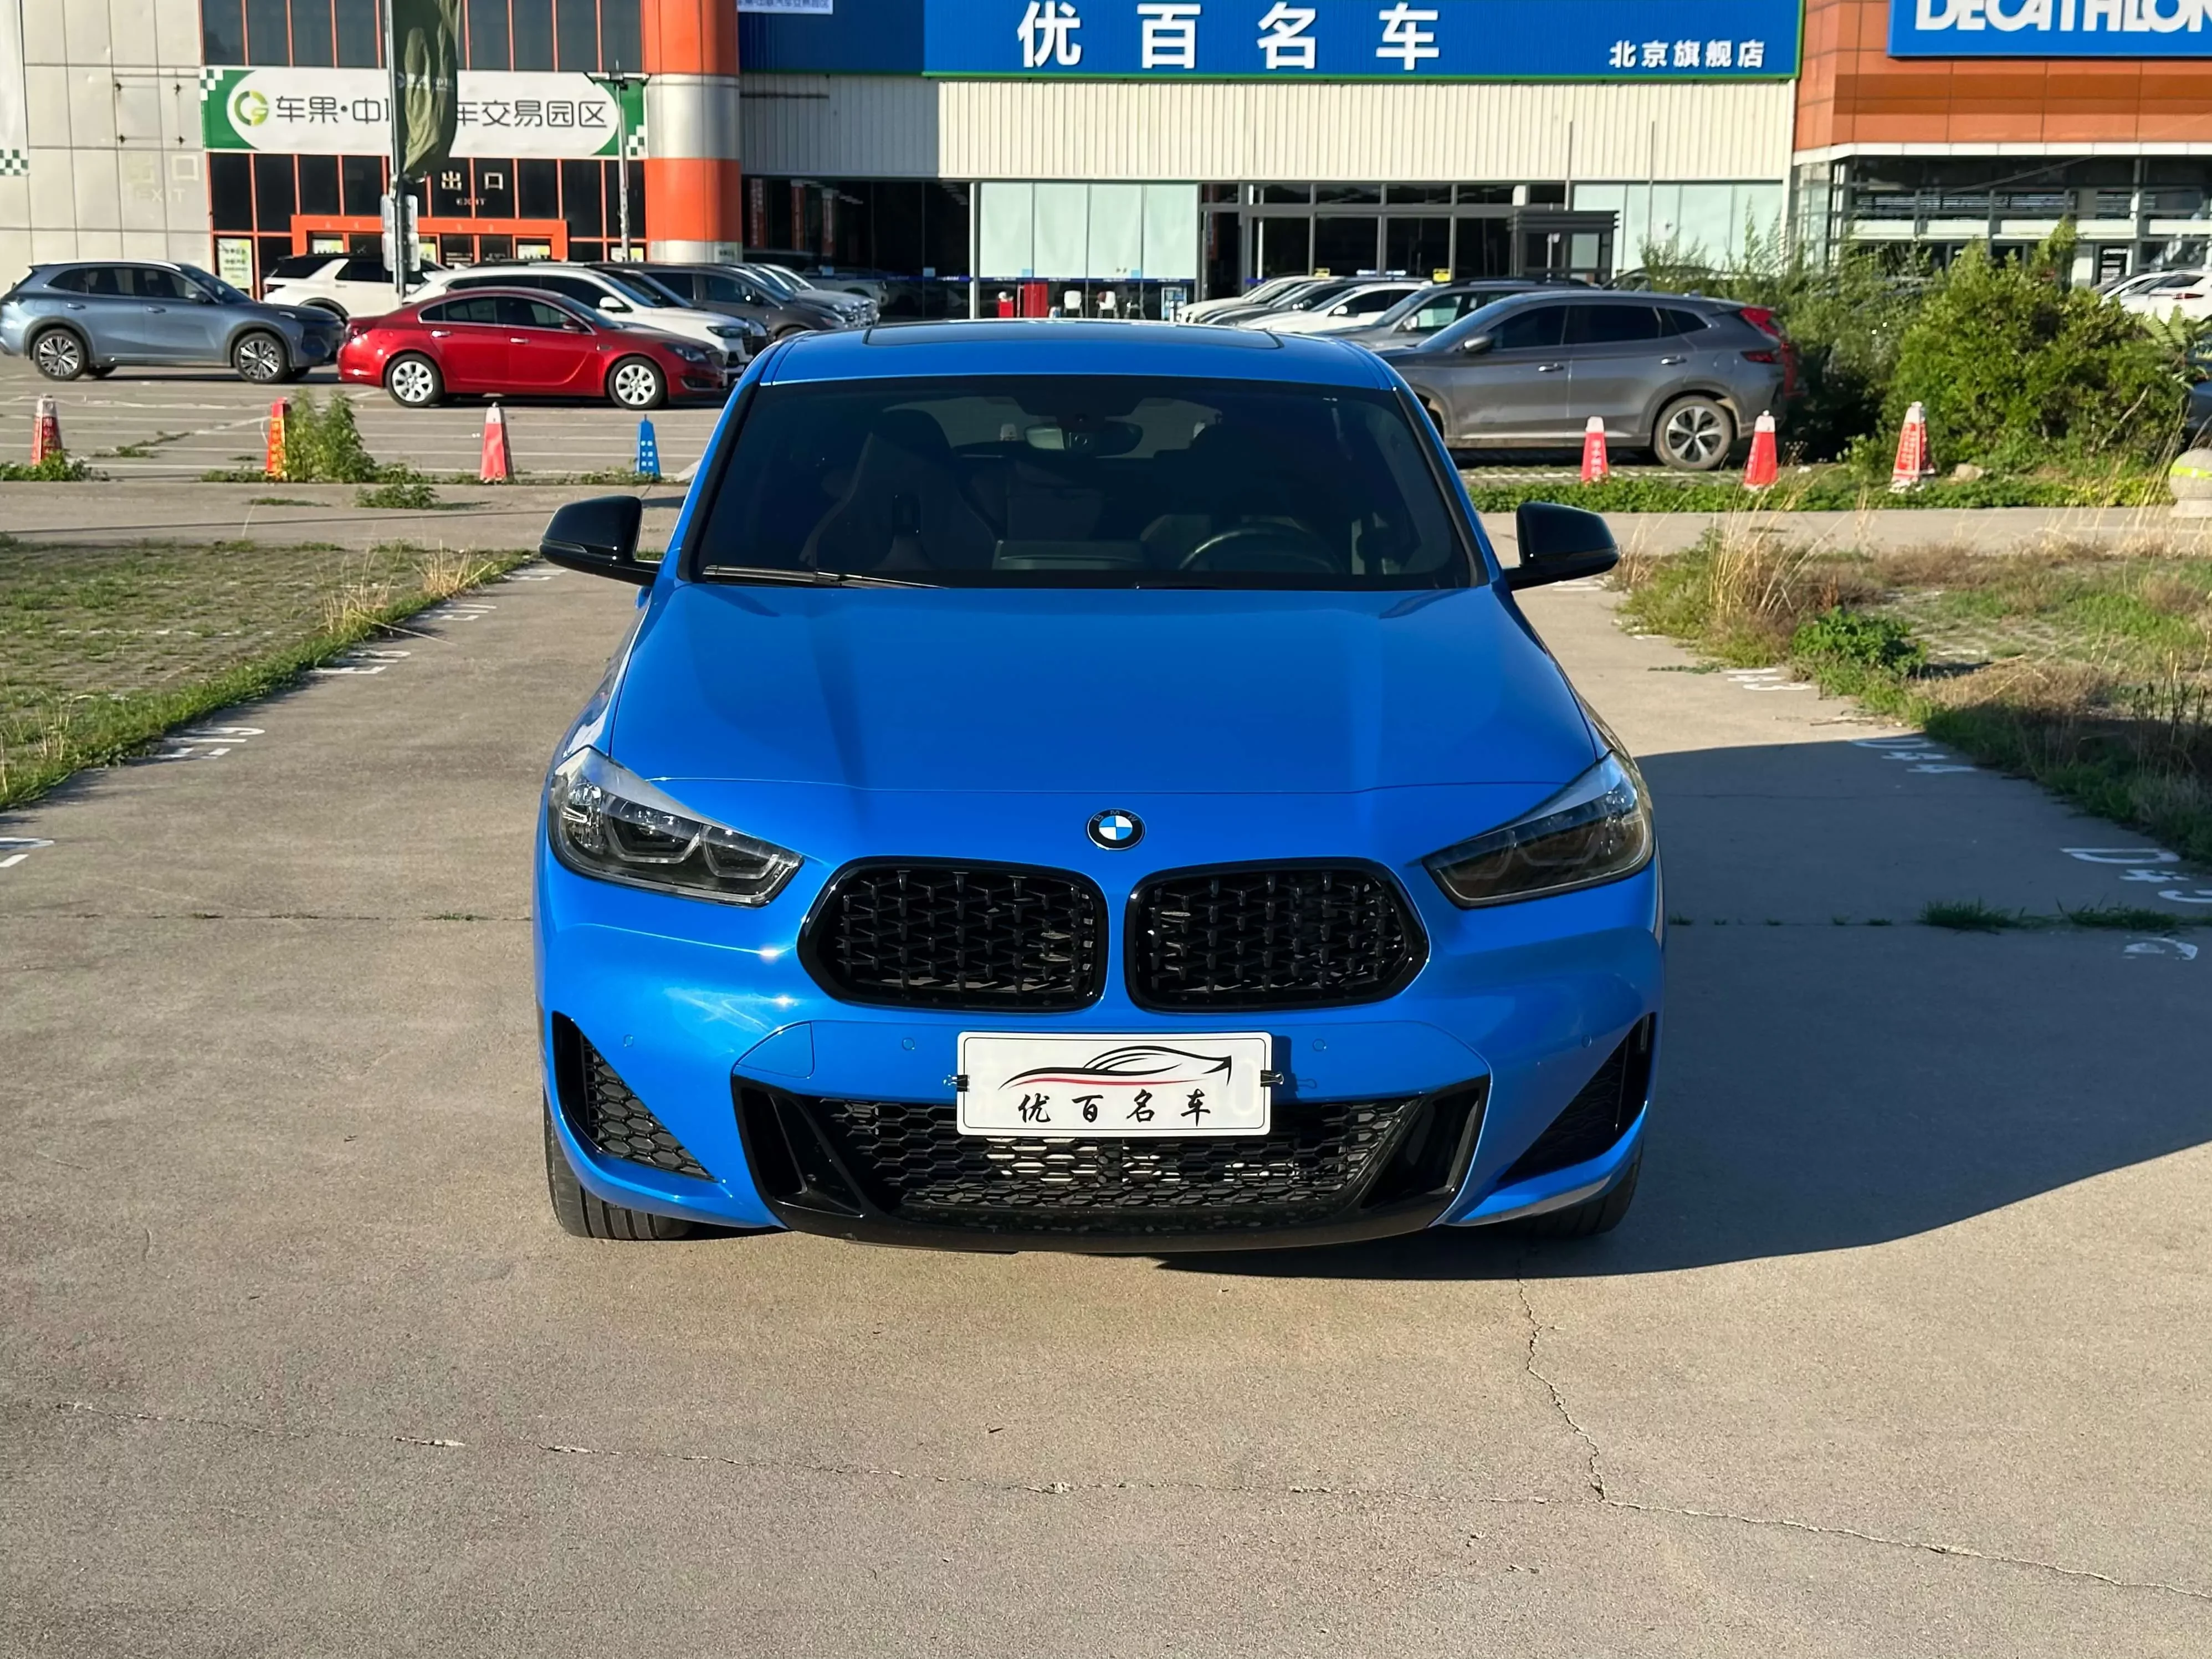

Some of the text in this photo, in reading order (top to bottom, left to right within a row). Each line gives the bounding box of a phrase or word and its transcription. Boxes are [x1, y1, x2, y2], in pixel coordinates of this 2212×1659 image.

[1016, 1, 1440, 70] 优百名车
[1608, 39, 1765, 68] 北京旗舰店
[441, 170, 504, 191] 出口
[1093, 810, 1139, 822] BMW
[1017, 1088, 1211, 1127] 优百名车
